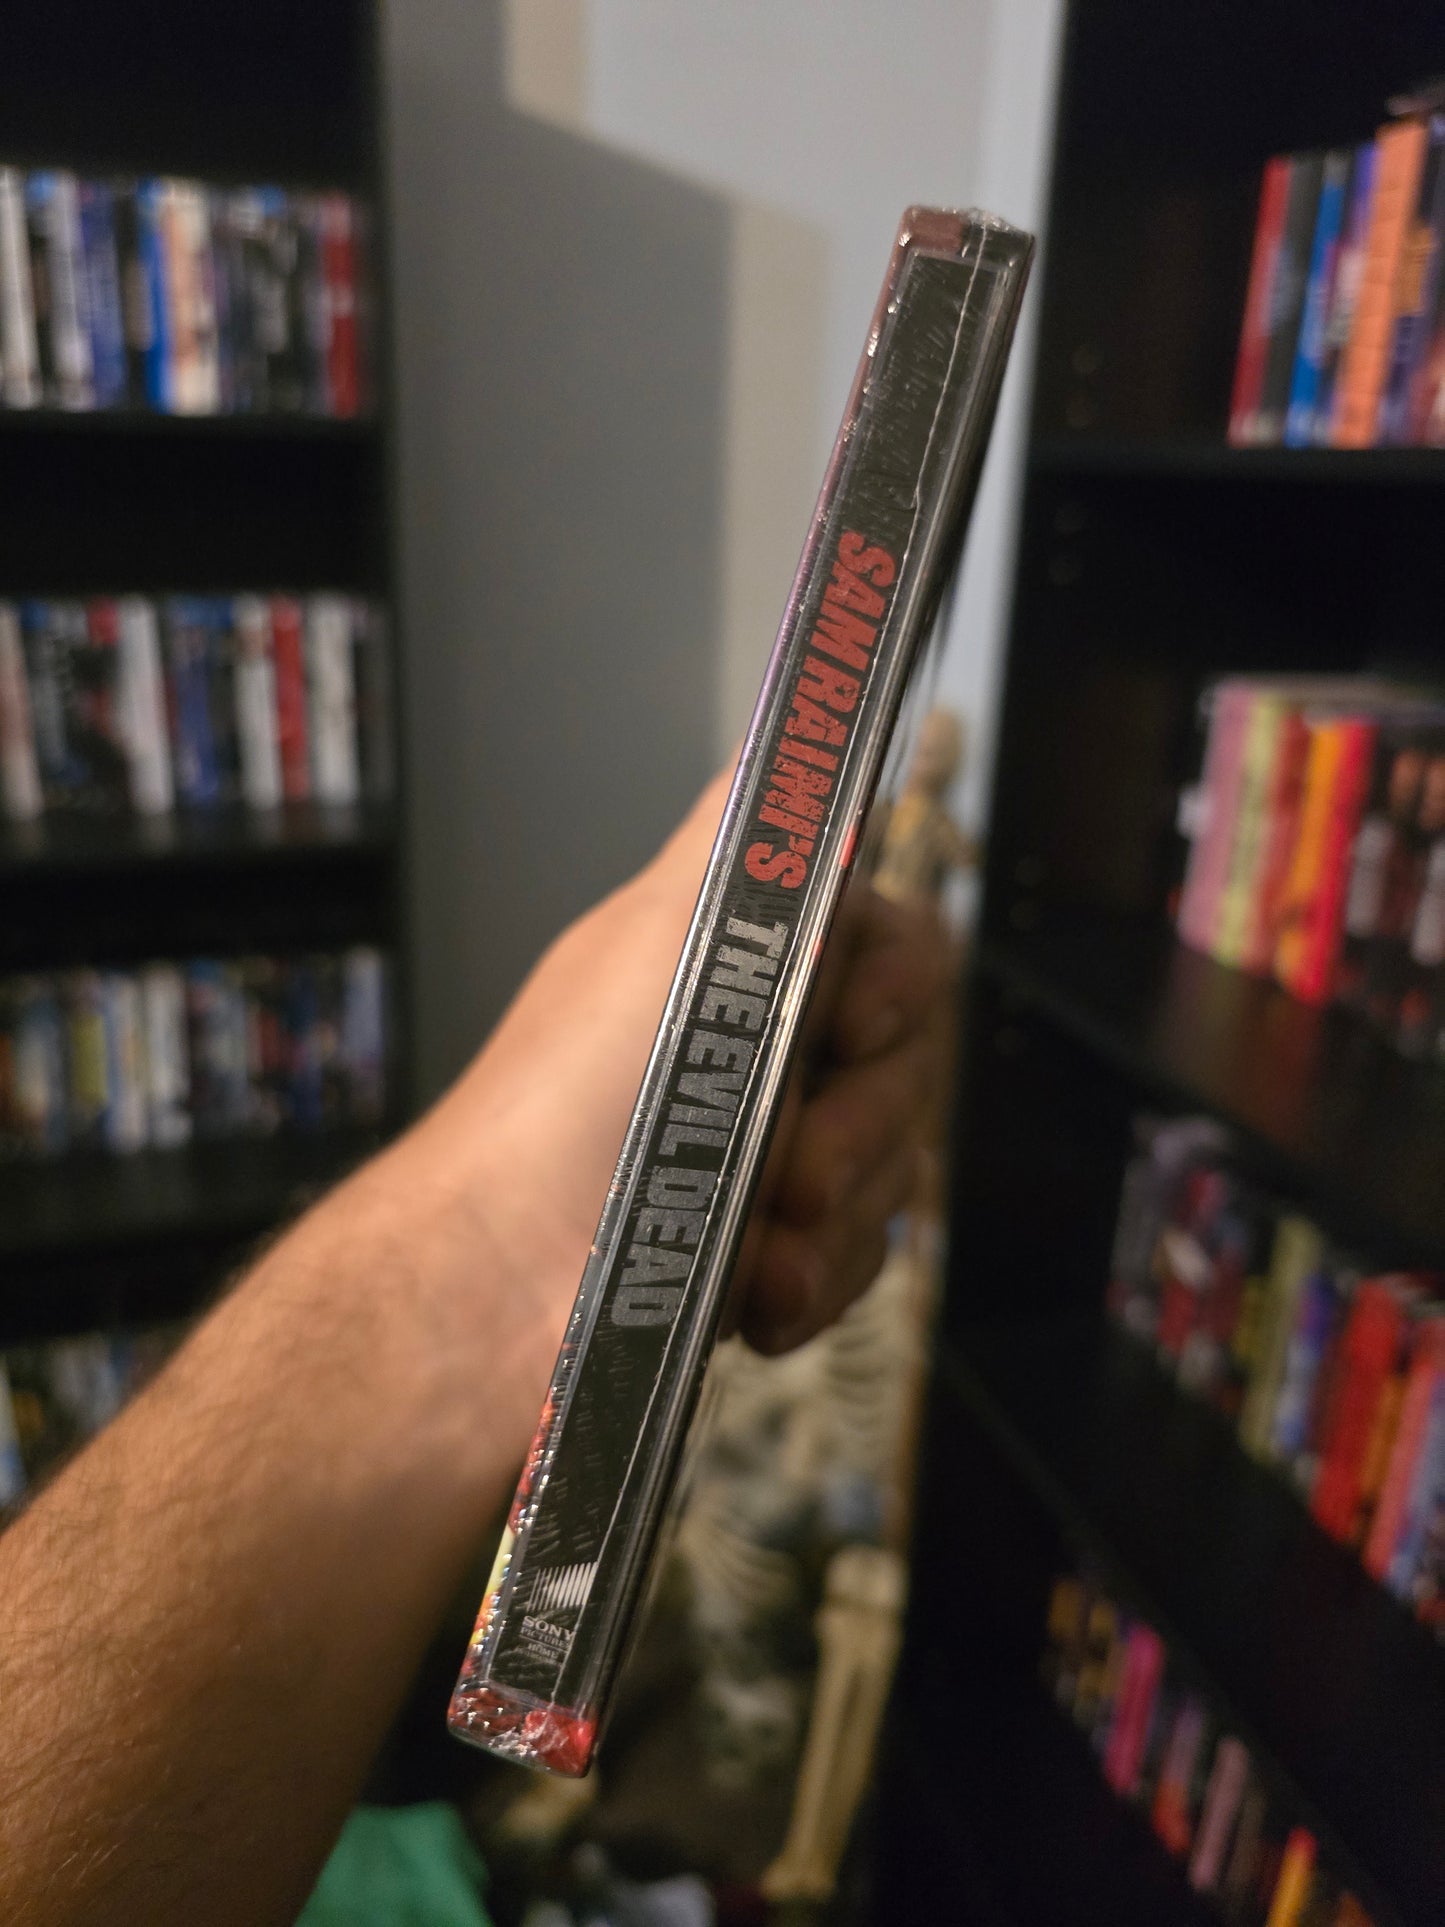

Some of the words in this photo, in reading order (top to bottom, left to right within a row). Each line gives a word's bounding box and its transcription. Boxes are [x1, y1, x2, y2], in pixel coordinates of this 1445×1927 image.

[810, 531, 895, 672] SAM
[745, 655, 860, 889] RAIMI'S
[699, 916, 789, 1033] THE
[659, 1028, 754, 1156] EVIL
[611, 1165, 717, 1327] DEAD
[520, 1626, 570, 1649] PICTURES
[522, 1615, 576, 1641] SONY
[527, 1643, 559, 1660] HOME
